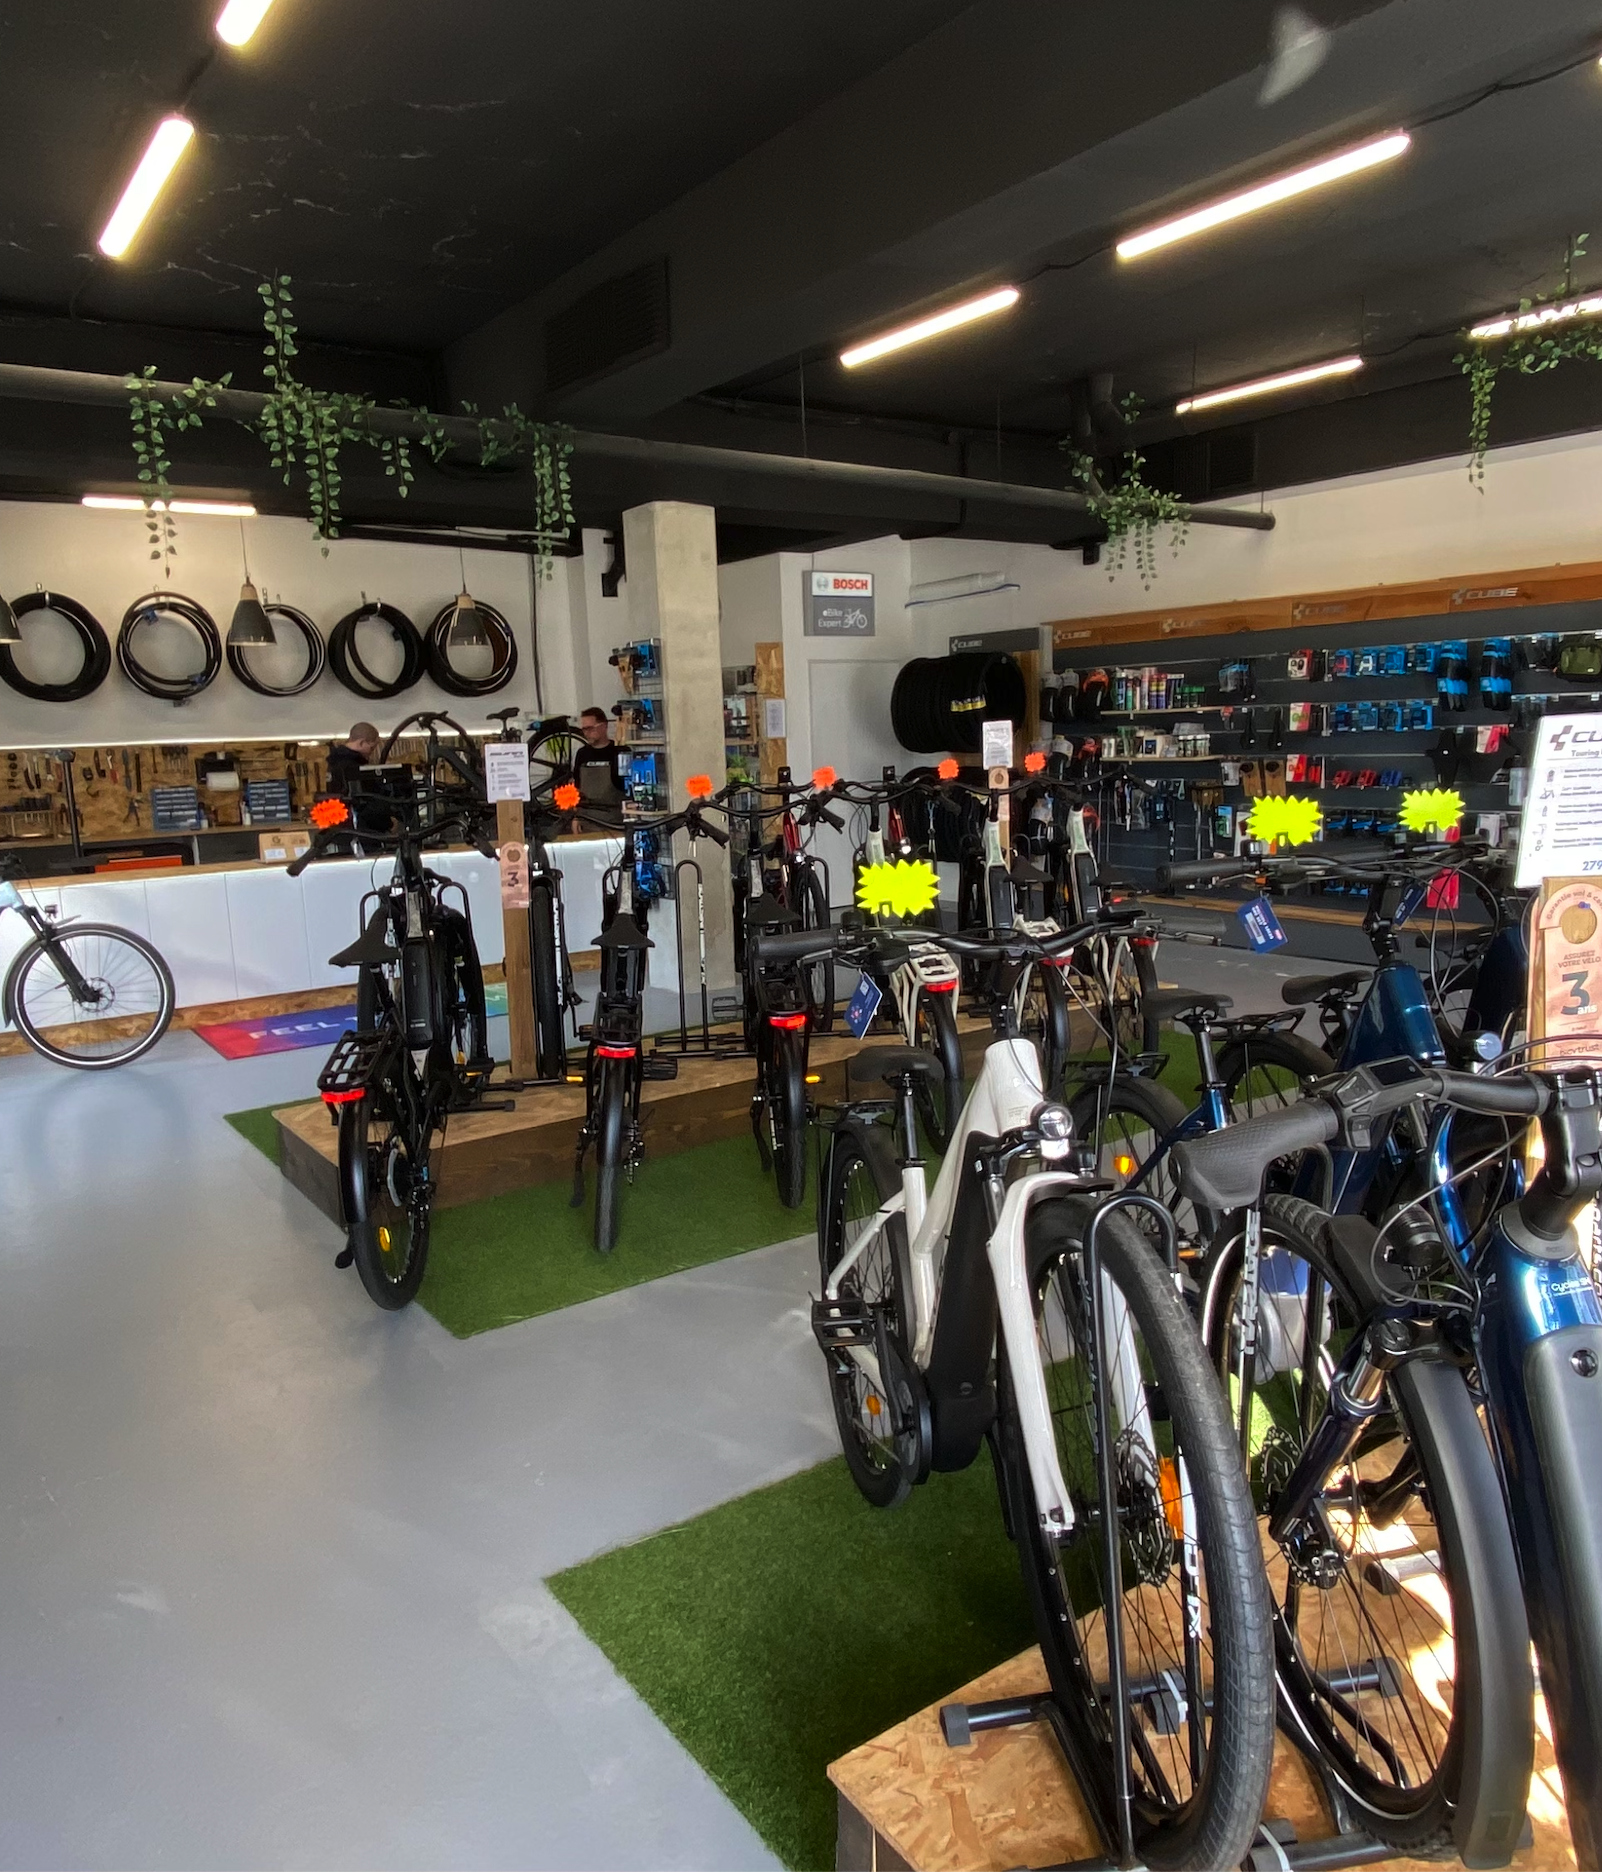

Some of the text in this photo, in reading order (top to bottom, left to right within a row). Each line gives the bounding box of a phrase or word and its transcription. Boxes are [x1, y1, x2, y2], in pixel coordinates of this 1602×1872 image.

[833, 578, 868, 590] BOSCH
[1466, 587, 1518, 600] CUBE
[818, 618, 842, 629] Expert
[1571, 749, 1600, 757] Touring
[507, 871, 519, 887] 3
[1546, 893, 1572, 920] Garantie
[1563, 950, 1596, 961] ASSUREZ
[1558, 958, 1581, 968] VOTRE
[1561, 970, 1590, 1015] 3
[1577, 1004, 1598, 1015] ans
[248, 1021, 341, 1039] FEEL
